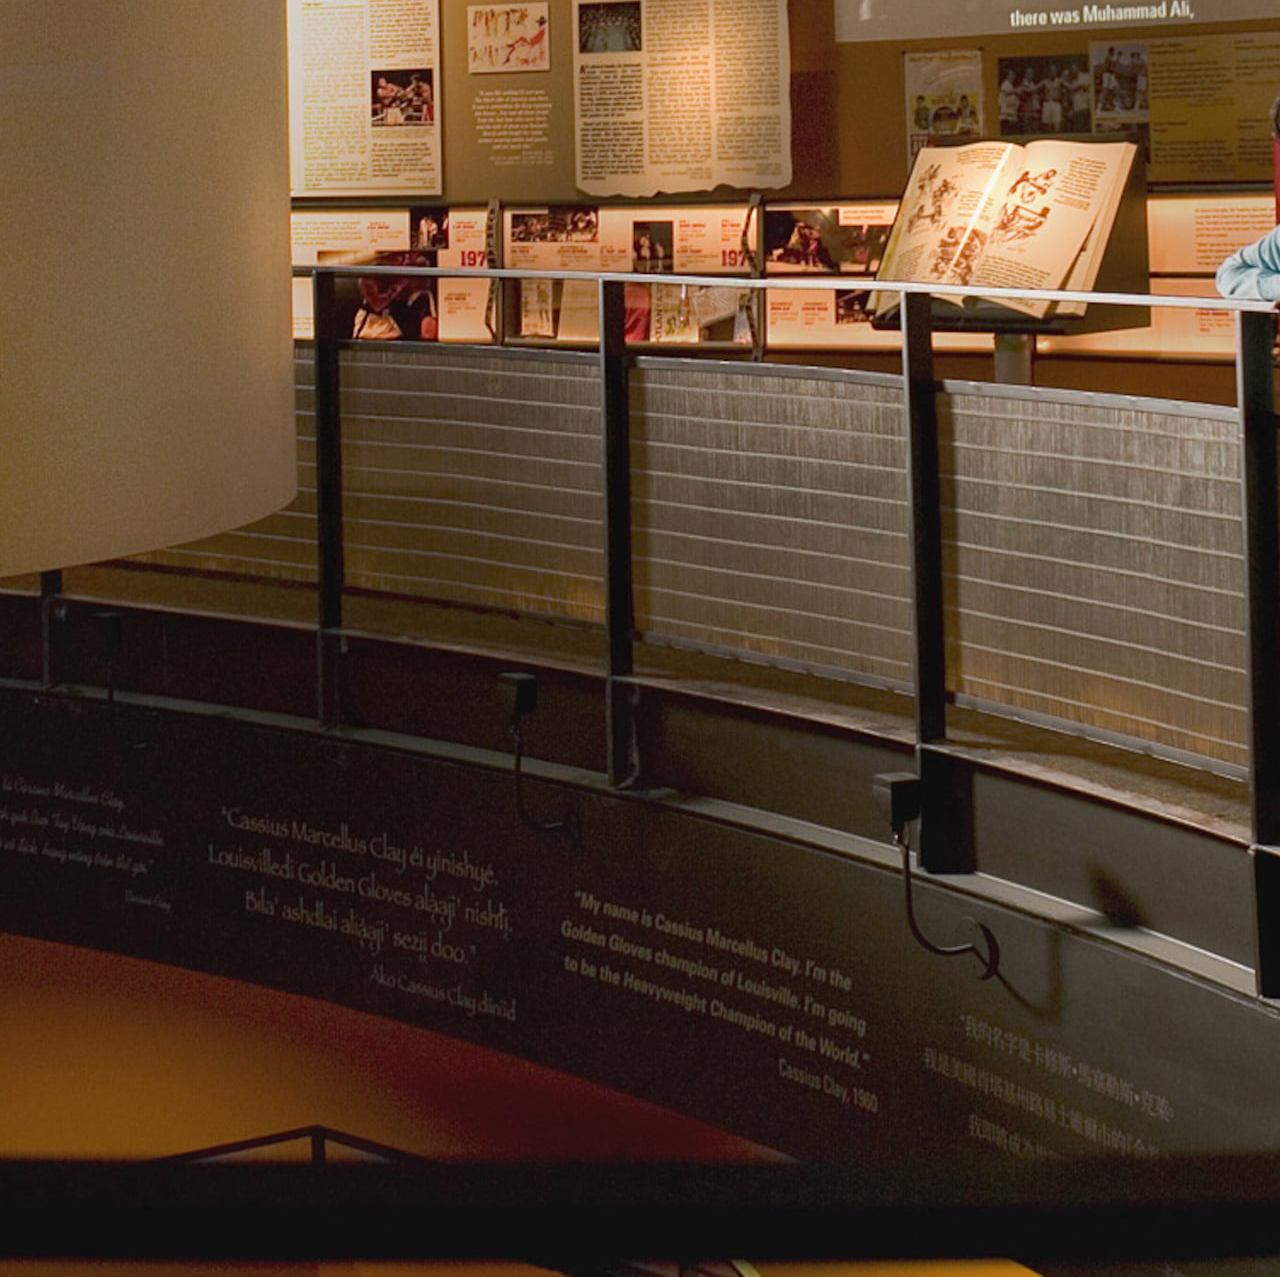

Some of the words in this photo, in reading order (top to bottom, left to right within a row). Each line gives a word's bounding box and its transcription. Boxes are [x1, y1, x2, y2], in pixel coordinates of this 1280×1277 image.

[1010, 8, 1046, 27] there
[1049, 8, 1081, 25] was
[1083, 2, 1167, 22] Muhammad
[1170, 0, 1194, 20] Ali,
[291, 820, 367, 854] Marcellus
[369, 831, 407, 873] Clay
[297, 860, 355, 893] Golden
[357, 872, 413, 907] Gloves
[603, 901, 639, 924] name
[641, 908, 653, 929] is
[654, 913, 704, 944] Cassius
[705, 927, 768, 963] Marcellus
[771, 947, 802, 978] Clay.
[830, 968, 852, 992] the
[446, 984, 476, 1017] Clay
[561, 919, 606, 948] Golden
[608, 932, 652, 962] Gloves
[654, 947, 718, 983] champion
[720, 972, 735, 987] of
[737, 972, 801, 1010] Louisville.
[828, 1008, 867, 1037] going
[564, 954, 578, 973] to
[580, 957, 597, 978] be
[599, 964, 620, 986] the
[623, 971, 707, 1014] Heavyweight
[710, 999, 776, 1037] Champion
[778, 1025, 794, 1042] of
[795, 1029, 817, 1052] the
[778, 1057, 821, 1090] Cassius
[823, 1074, 850, 1104] Clay,
[852, 1088, 879, 1113] 1960
